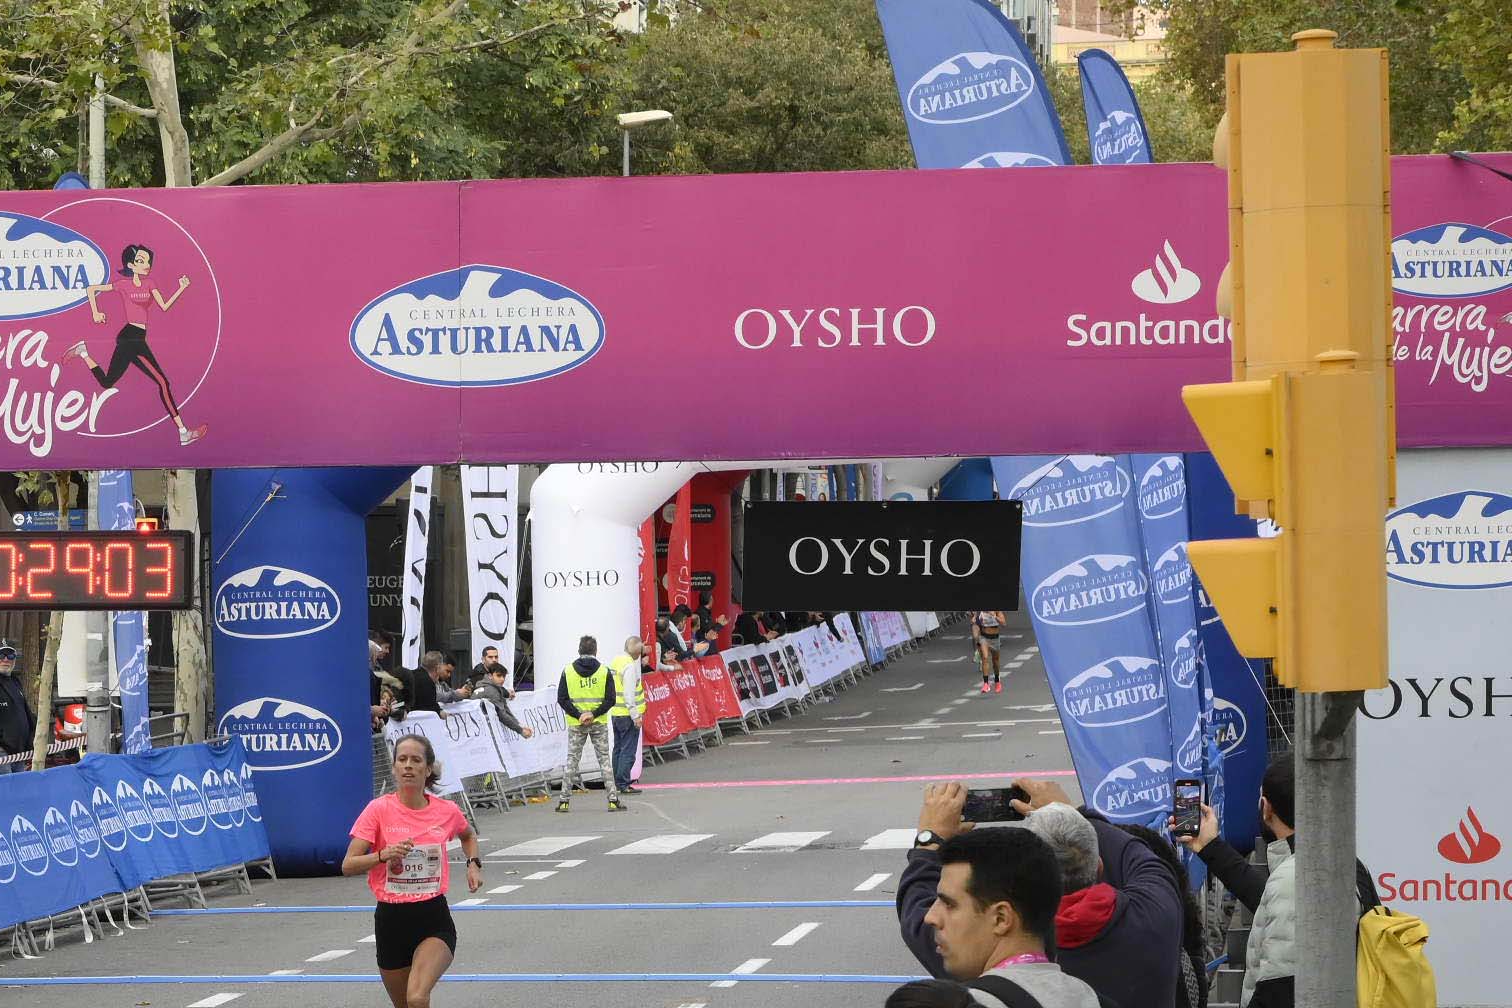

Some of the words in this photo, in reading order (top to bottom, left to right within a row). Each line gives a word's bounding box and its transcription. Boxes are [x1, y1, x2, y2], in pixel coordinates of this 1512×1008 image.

[13, 249, 85, 260] LECHERA
[1406, 249, 1458, 257] CENTRAL
[409, 307, 487, 321] CENTRAL
[496, 305, 577, 318] LECHERA
[1392, 303, 1487, 333] arrera
[370, 312, 585, 358] ASTURIANA
[733, 305, 937, 350] OYSHO
[1066, 313, 1233, 348] Santand
[1416, 333, 1433, 360] la
[1429, 327, 1512, 393] Muje
[1413, 526, 1480, 535] CENTRAL
[788, 535, 982, 578] OYSHO
[1385, 529, 1512, 565] ASTURIA
[544, 569, 620, 589] OYSHO
[231, 591, 273, 600] CENTRAL
[278, 590, 327, 599] LECHERA
[219, 596, 332, 623] ASTURIANA
[1360, 675, 1512, 721] OYSH
[233, 723, 273, 731] CENTRAL
[279, 722, 327, 730] LECHERA
[405, 864, 423, 872] 016
[1377, 872, 1512, 902] Santan
